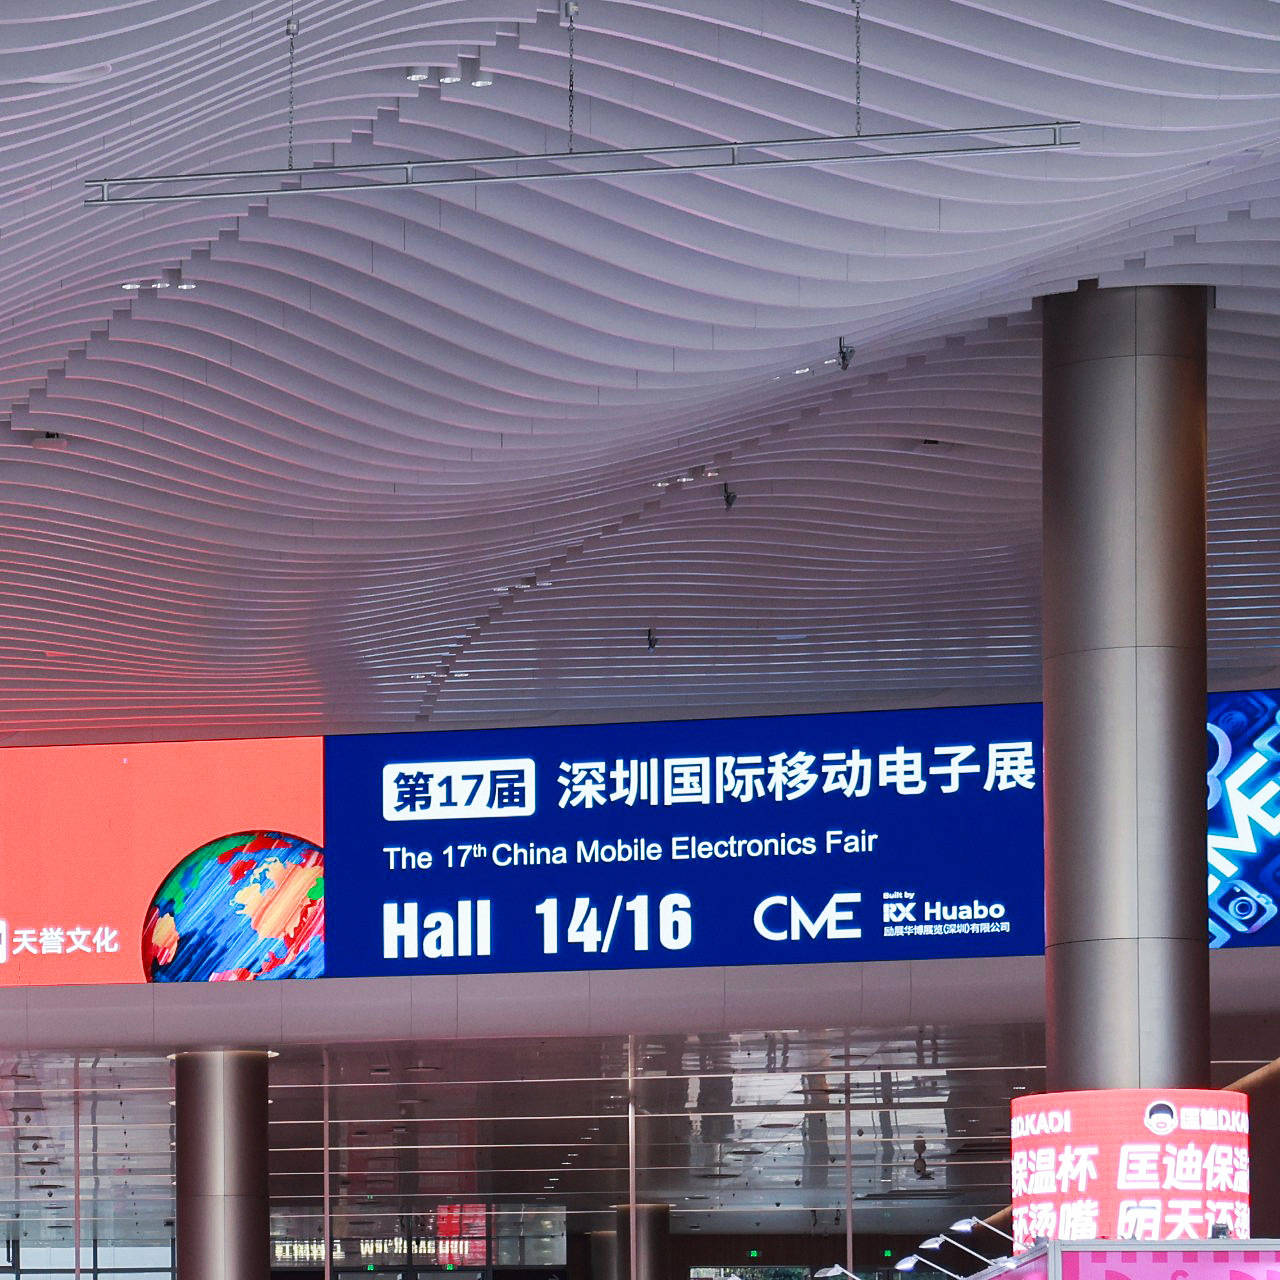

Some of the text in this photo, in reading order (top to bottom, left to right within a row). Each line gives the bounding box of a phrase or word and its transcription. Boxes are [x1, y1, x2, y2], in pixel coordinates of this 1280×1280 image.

[392, 767, 526, 814] 第17届
[556, 741, 1037, 810] 深圳国际移动电子展
[382, 829, 878, 870] The 17th China Mobile Electronics Fair
[882, 891, 915, 900] Built by
[882, 900, 1006, 923] RX Huabo
[382, 892, 693, 960] Hall 14/16
[753, 892, 862, 942] CME
[883, 922, 1011, 937] 励展华博展览(深圳)有限公司
[12, 926, 120, 955] 天誉文化
